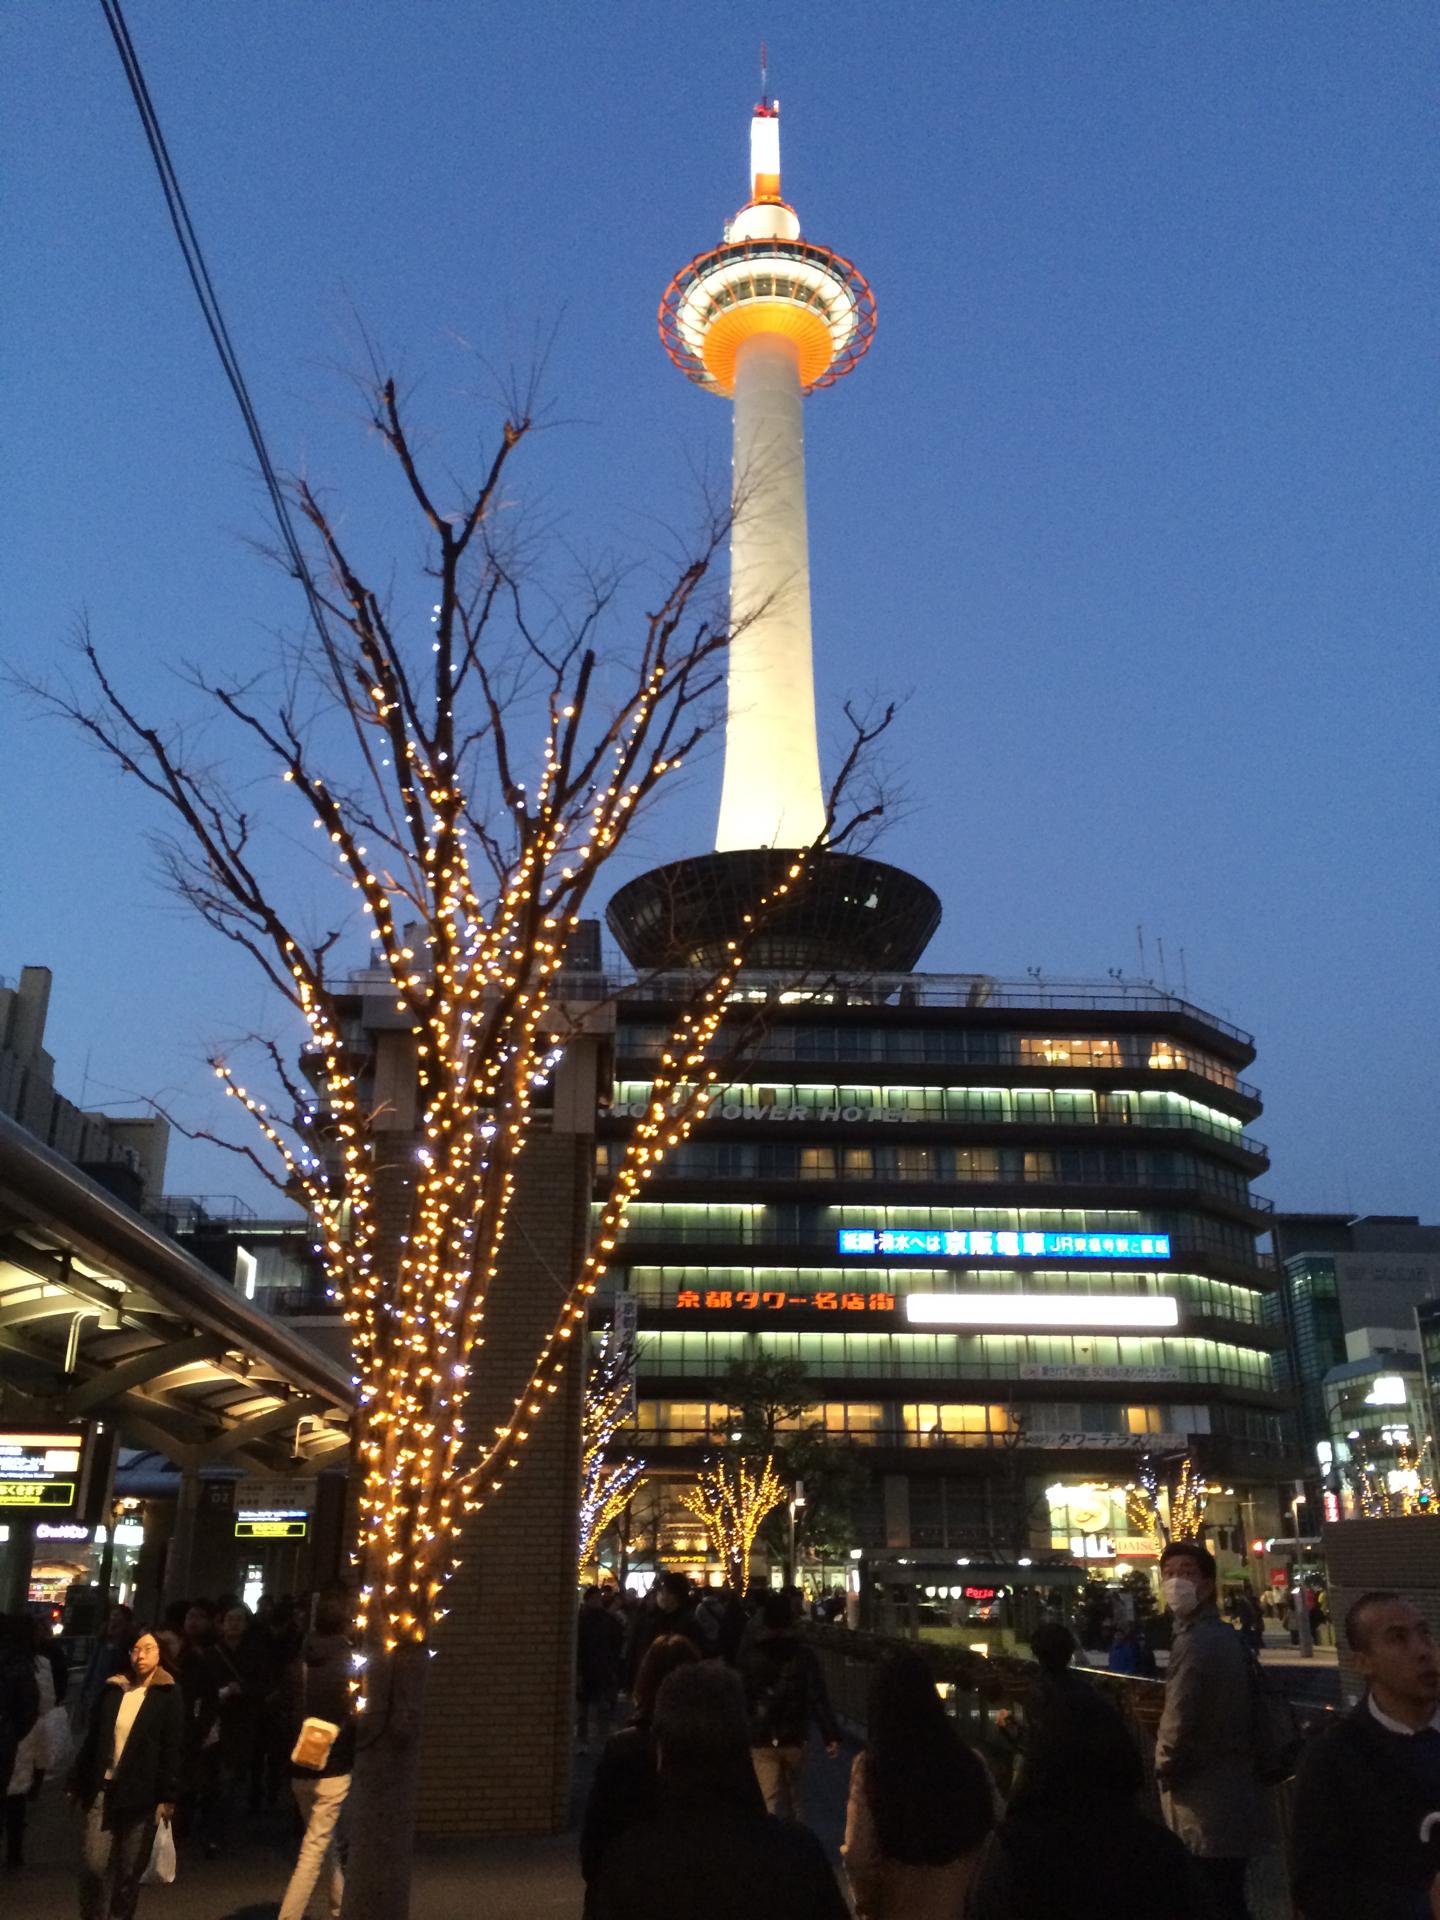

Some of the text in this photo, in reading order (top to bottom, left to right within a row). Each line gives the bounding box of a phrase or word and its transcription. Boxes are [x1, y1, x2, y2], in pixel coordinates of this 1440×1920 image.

[706, 1104, 806, 1120] TOWER
[819, 1105, 917, 1123] HOTEL
[676, 1290, 896, 1311] 京都タワー名店街
[965, 1586, 994, 1599] Porta
